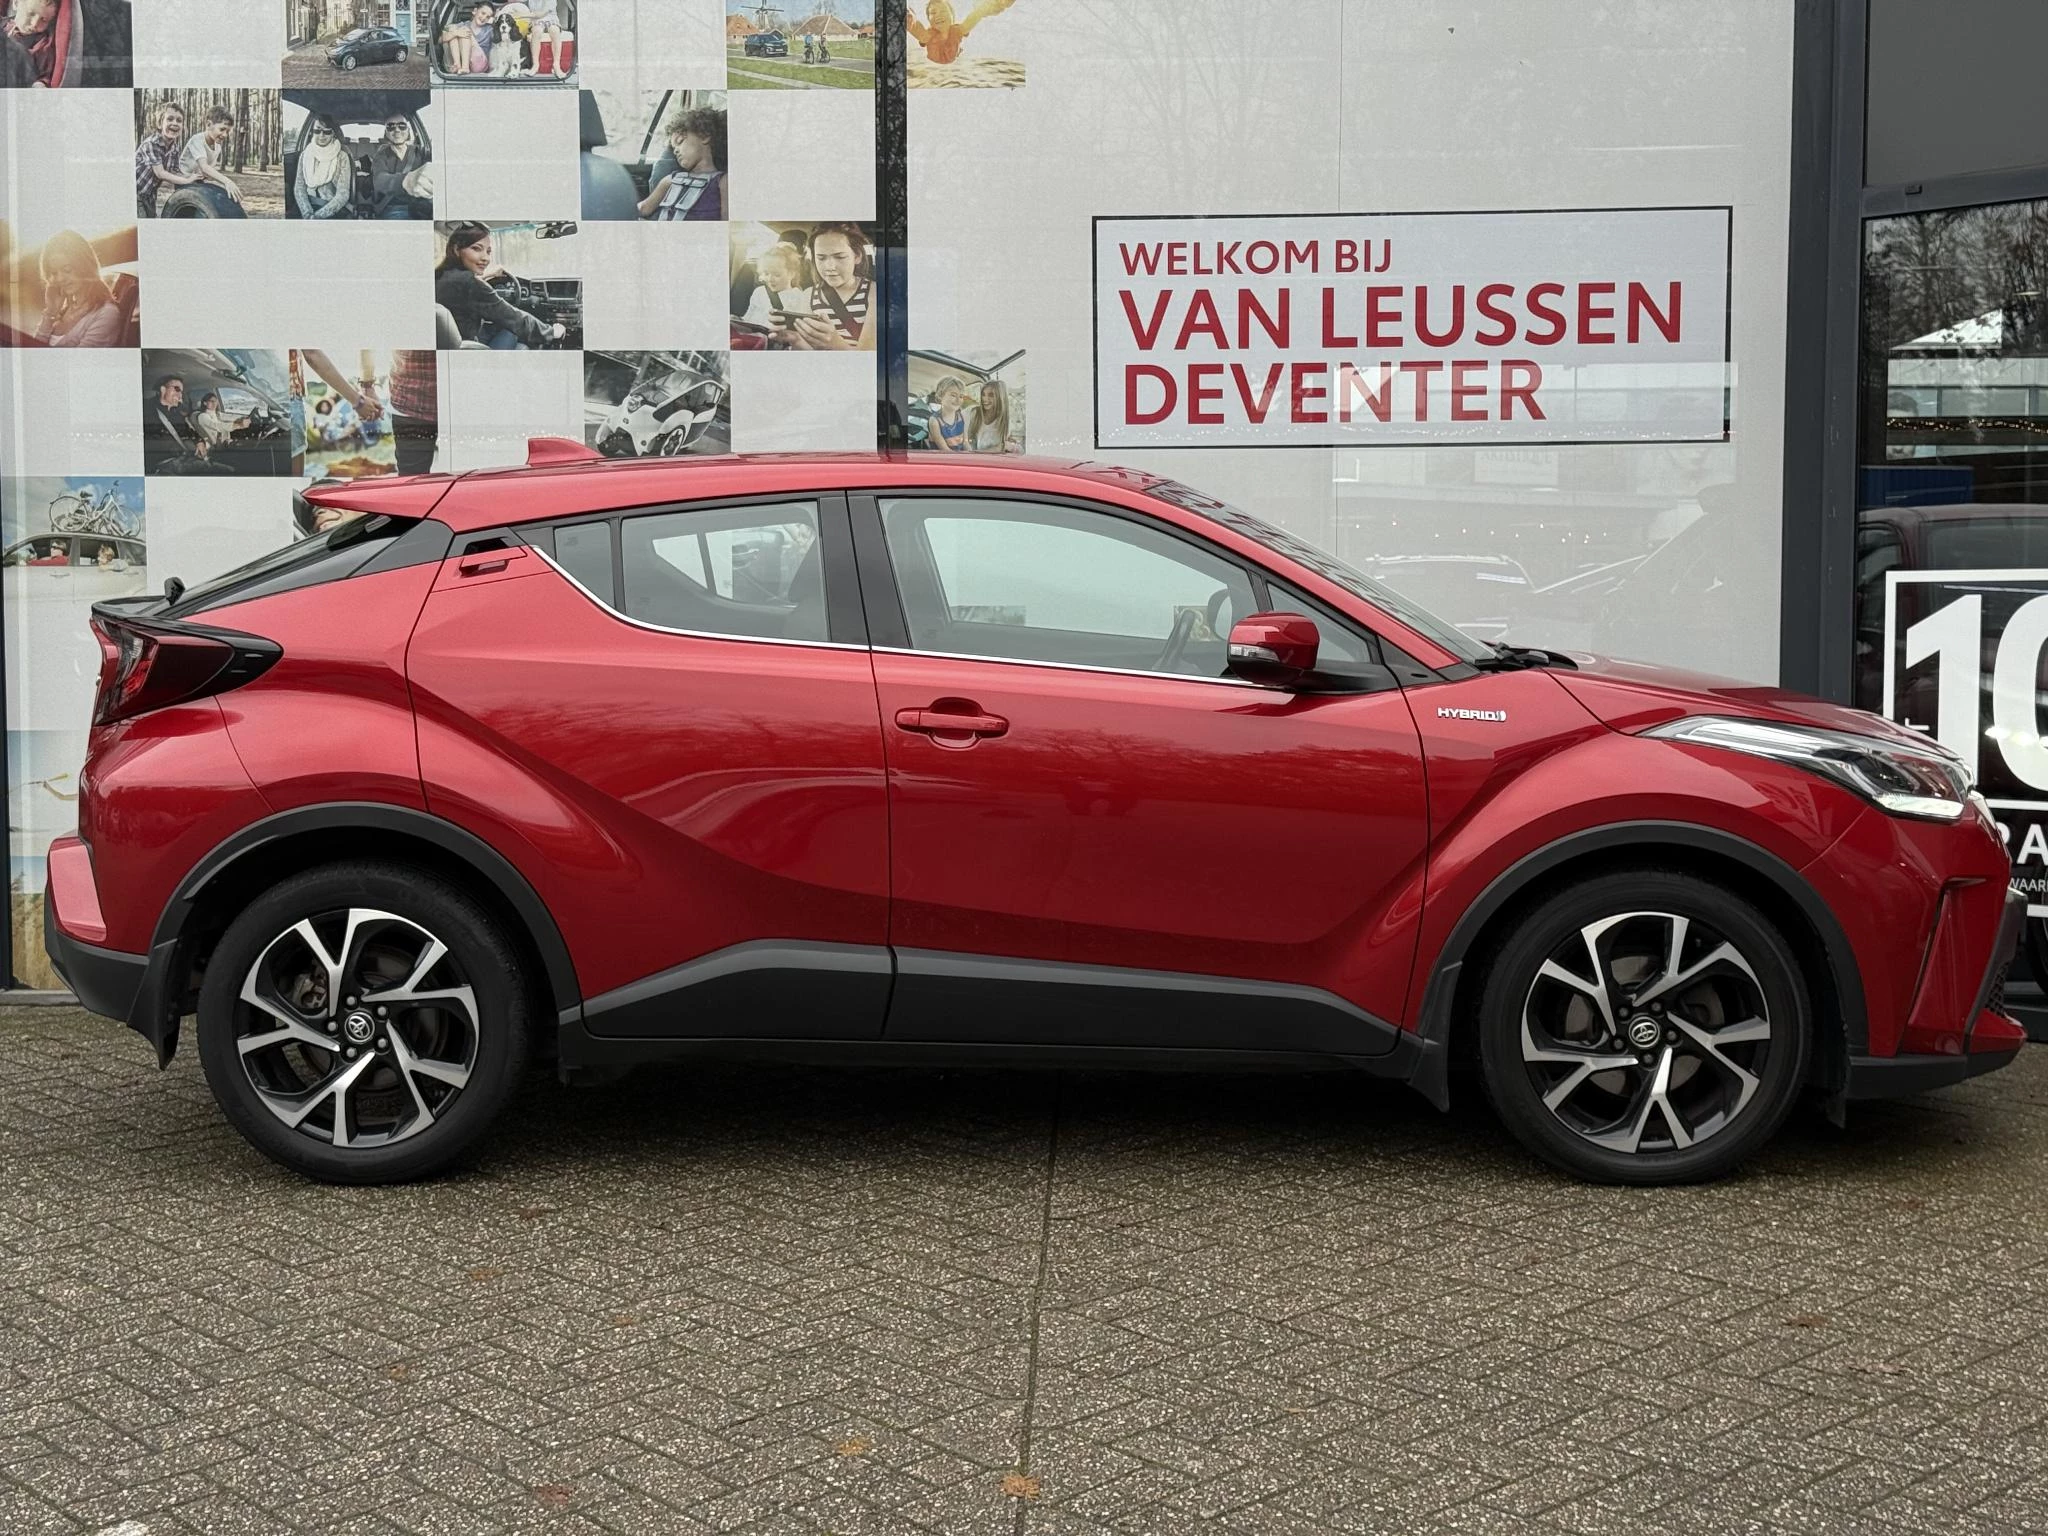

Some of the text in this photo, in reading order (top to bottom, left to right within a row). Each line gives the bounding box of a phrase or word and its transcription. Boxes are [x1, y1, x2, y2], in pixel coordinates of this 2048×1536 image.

[1119, 239, 1392, 275] WELKOM BIJ
[1119, 281, 1682, 350] VAN LEUSSEN
[1124, 359, 1546, 425] DEVENTER
[1437, 707, 1498, 721] HYBRID
